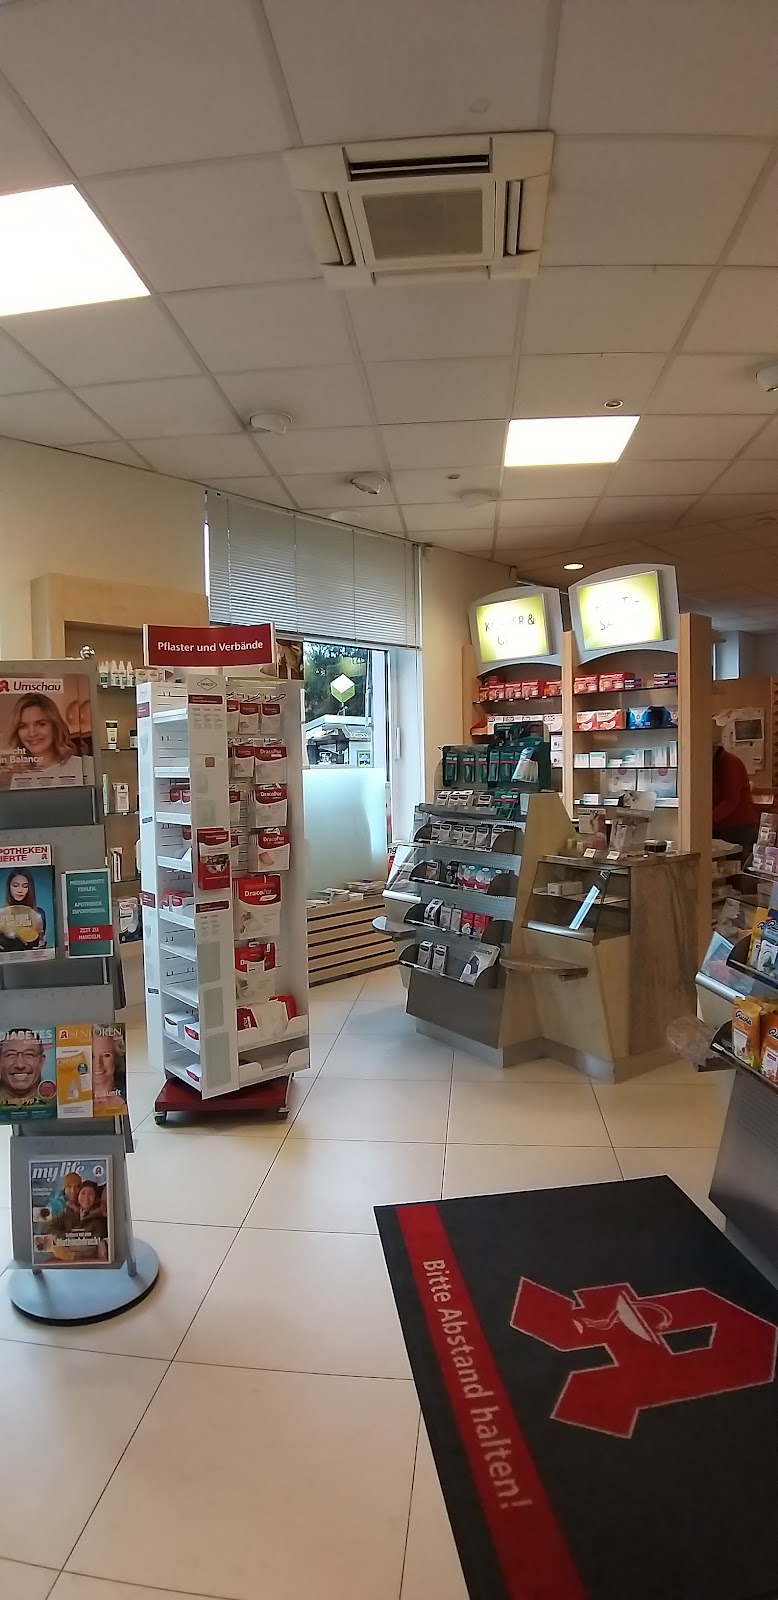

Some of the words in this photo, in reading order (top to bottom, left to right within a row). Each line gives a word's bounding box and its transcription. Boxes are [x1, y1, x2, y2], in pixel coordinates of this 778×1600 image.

[157, 641, 195, 652] Pflaster
[196, 642, 217, 652] und
[218, 640, 264, 651] Verbände
[13, 681, 61, 691] Umschau
[9, 755, 44, 764] Balance
[244, 889, 272, 897] DracoPor
[0, 1030, 52, 1040] DIABETES
[422, 1259, 451, 1304] Bitte
[438, 1307, 494, 1400] Abstand
[470, 1405, 533, 1510] halten!
